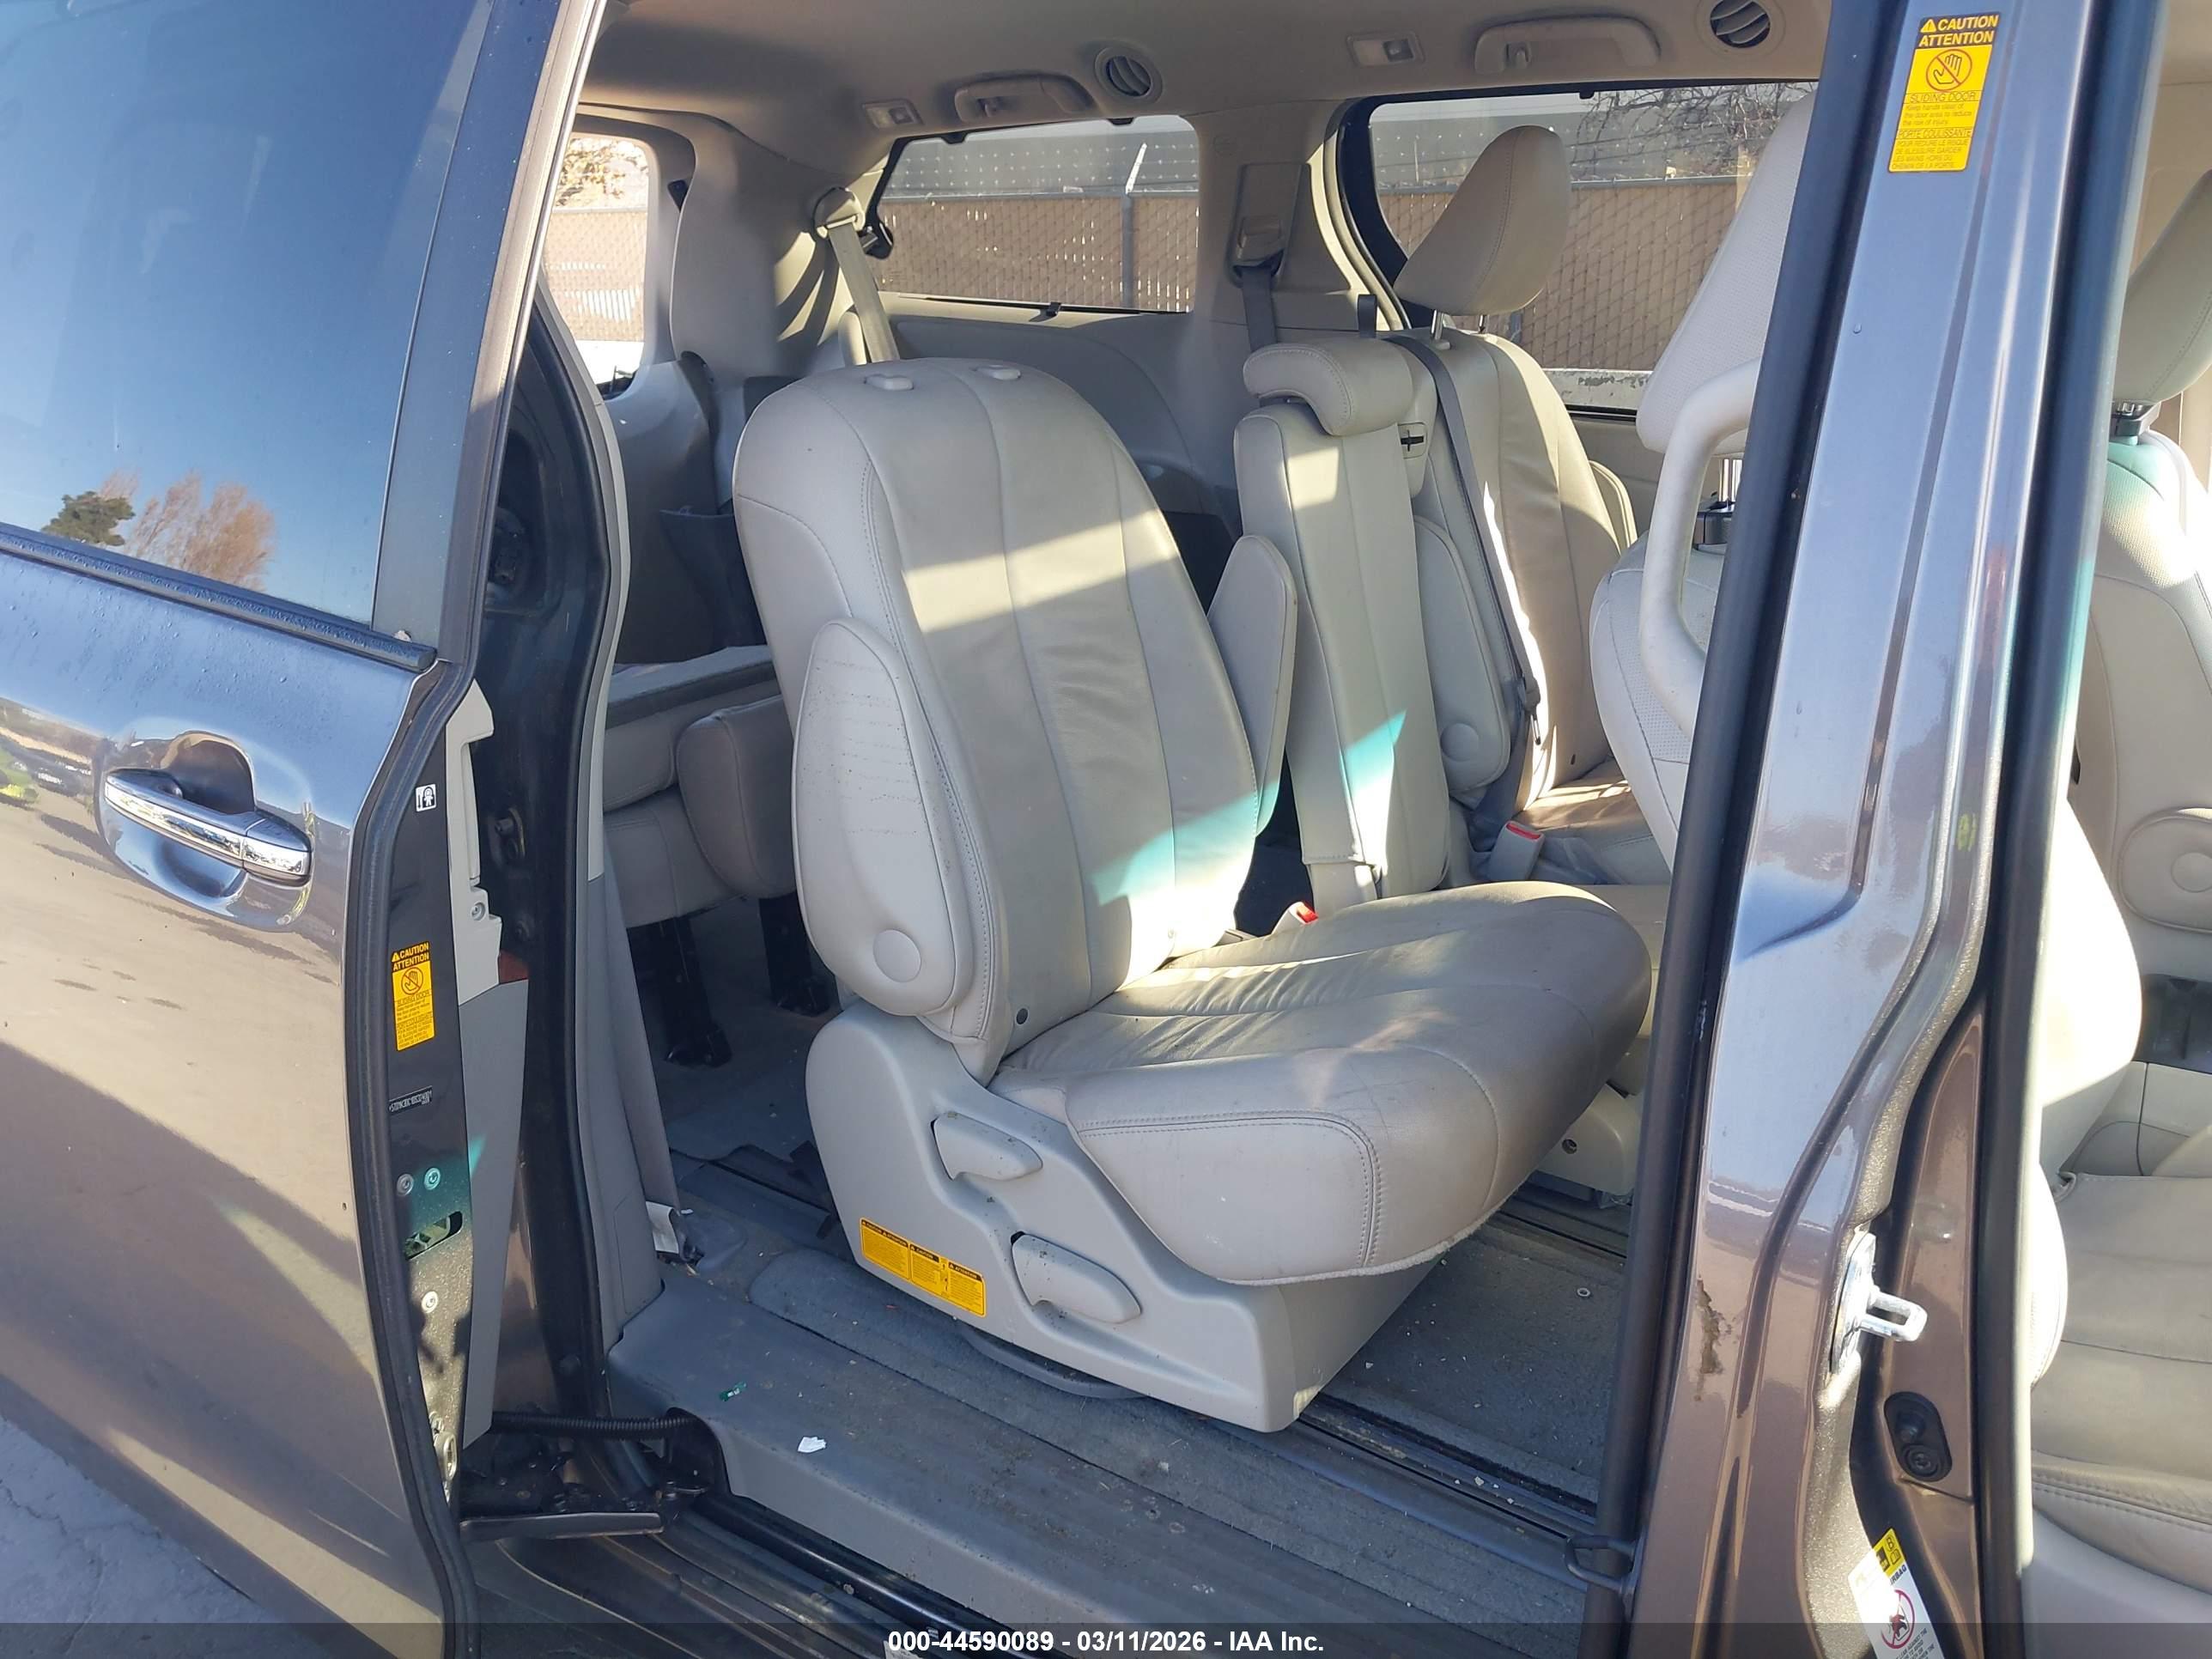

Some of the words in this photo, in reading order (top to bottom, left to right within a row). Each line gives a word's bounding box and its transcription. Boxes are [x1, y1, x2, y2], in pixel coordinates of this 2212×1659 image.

[1937, 14, 1999, 31] CAUTION
[1918, 30, 1995, 47] ATTENTION
[1910, 94, 1946, 104] SLIDING
[1948, 91, 1976, 101] DOOR
[399, 942, 429, 959] CAUTION
[392, 951, 429, 972] ATTENTION
[1889, 1564, 1907, 1586] IRBAG
